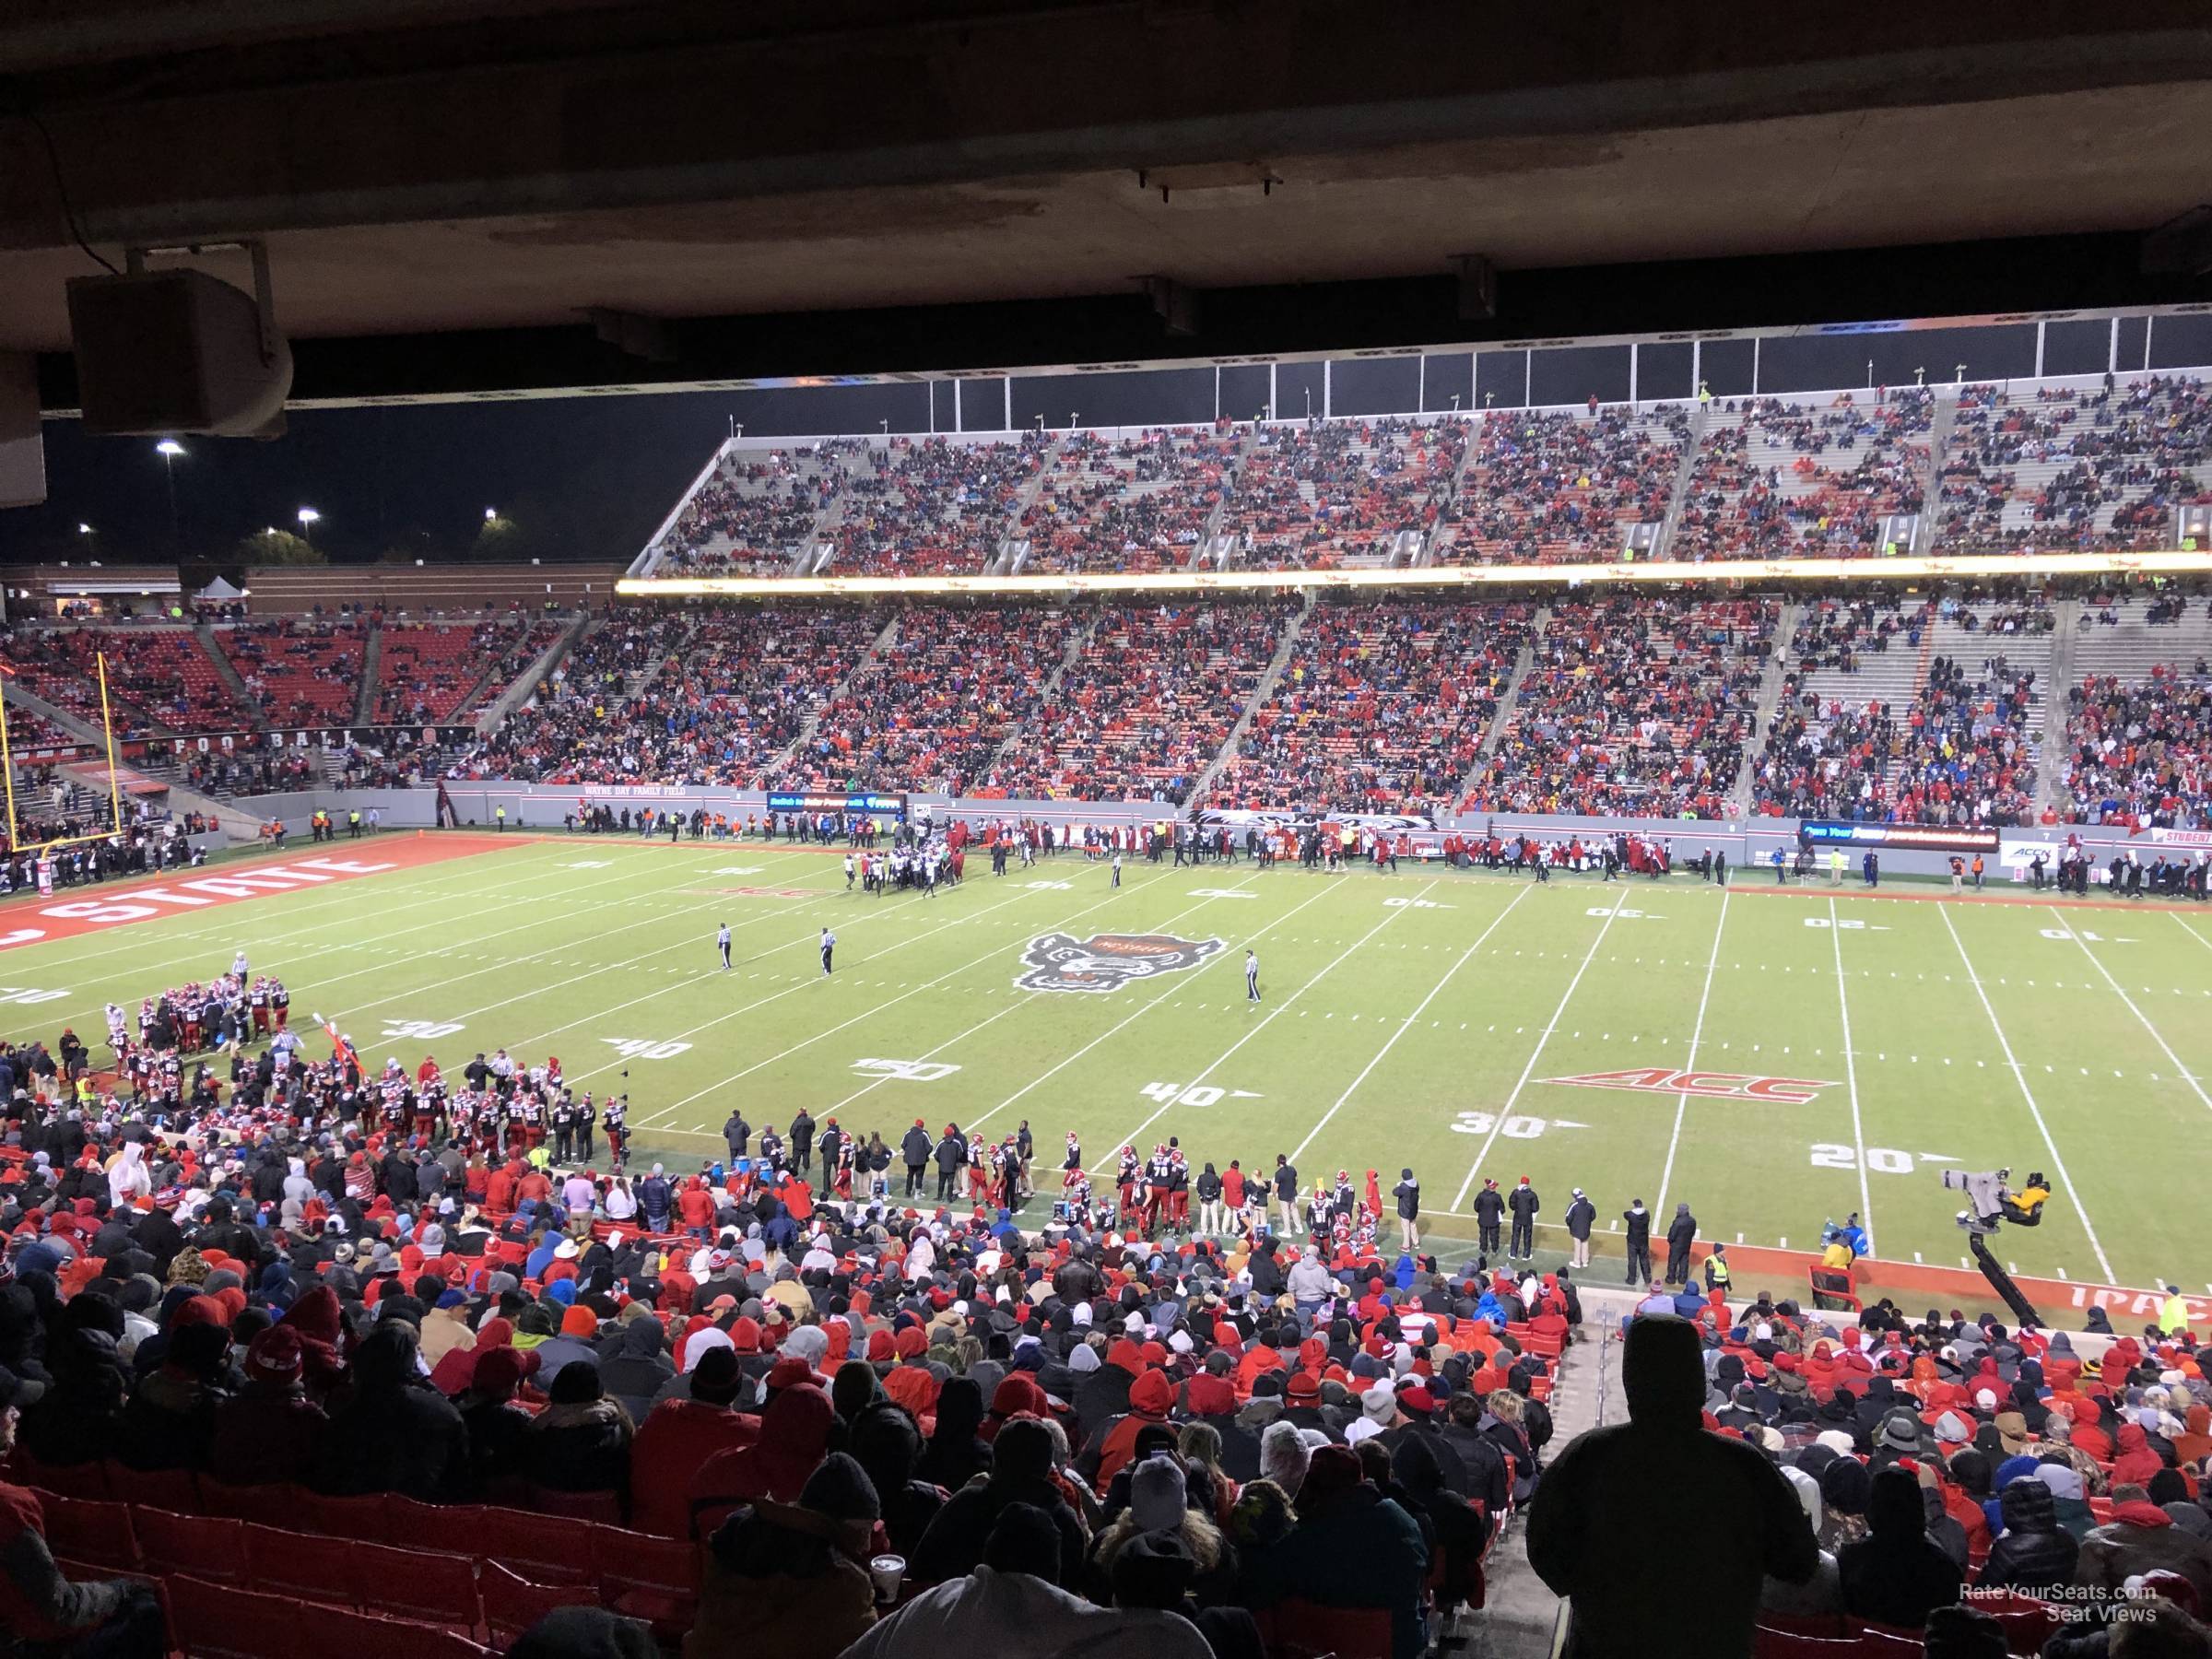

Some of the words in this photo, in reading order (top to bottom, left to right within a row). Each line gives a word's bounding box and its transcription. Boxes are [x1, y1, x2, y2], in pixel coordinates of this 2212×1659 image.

[175, 731, 351, 753] FOOBALL
[584, 786, 612, 795] WAYNE
[615, 786, 630, 795] DAY
[634, 786, 661, 795] FAMILY
[664, 786, 686, 795] FIELD
[2167, 831, 2212, 843] STUDENT
[38, 858, 398, 922] STATE
[381, 1020, 466, 1040] 30
[609, 1040, 694, 1059] 40
[1140, 1082, 1227, 1107] 40
[1530, 1067, 1843, 1104] ACC
[1450, 1111, 1548, 1139] 30
[1810, 1143, 1915, 1174] 20
